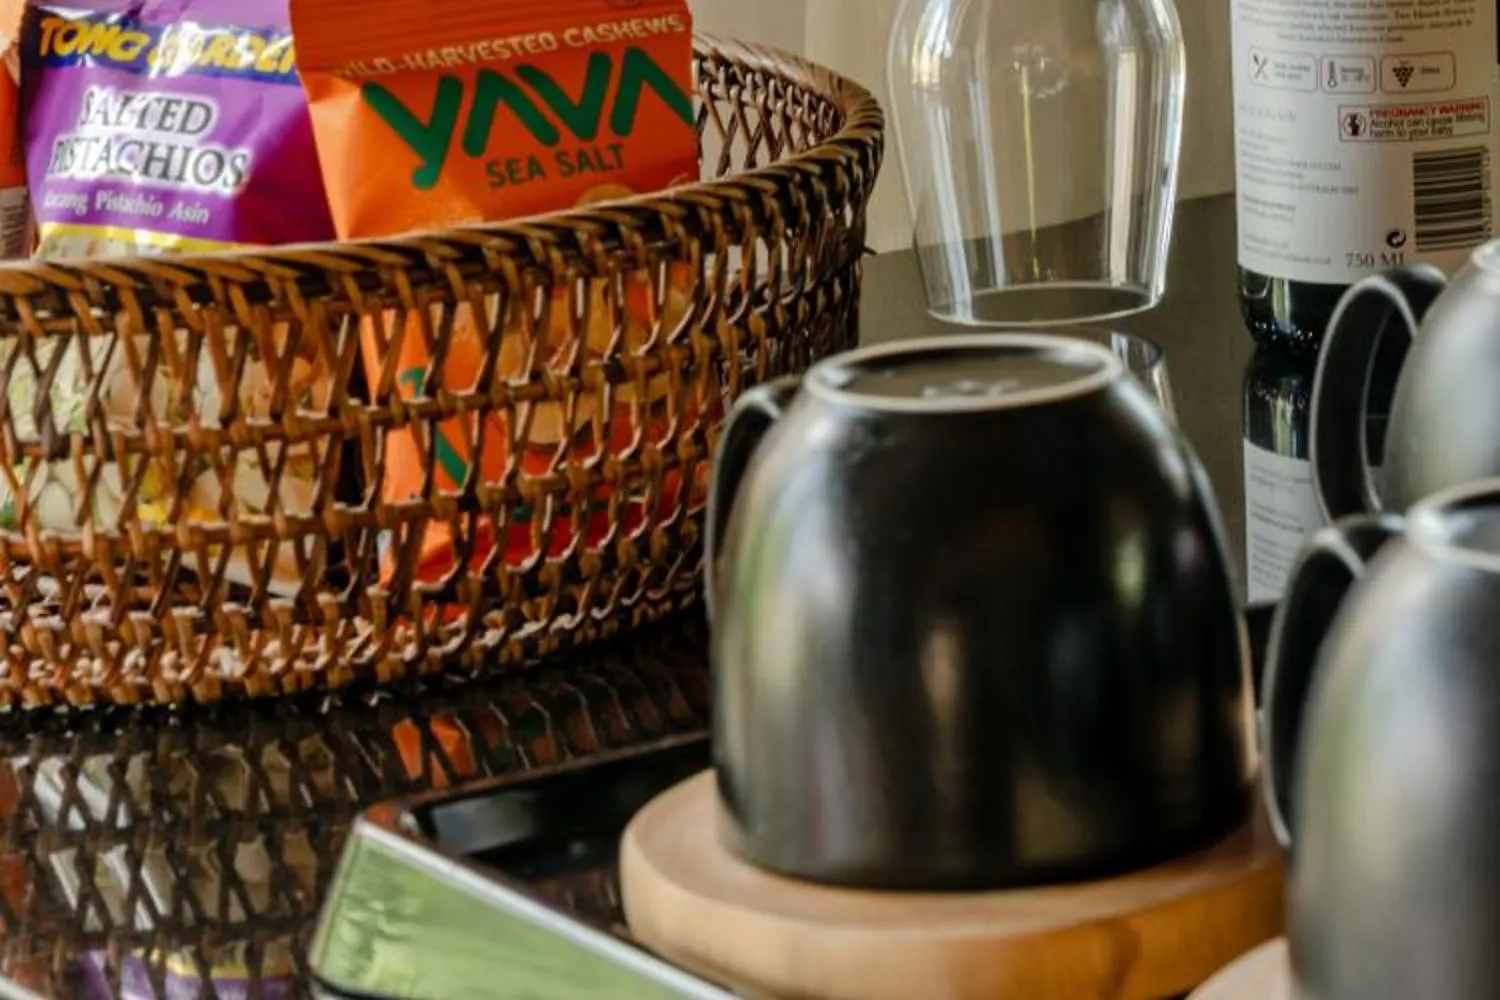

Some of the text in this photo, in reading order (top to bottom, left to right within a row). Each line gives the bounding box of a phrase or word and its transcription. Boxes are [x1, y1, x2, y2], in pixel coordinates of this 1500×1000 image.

[563, 14, 686, 49] CASHEWS
[361, 46, 696, 190] YAVA
[486, 144, 626, 188] SEA SALT
[167, 200, 209, 225] Asin
[1346, 254, 1375, 268] 750
